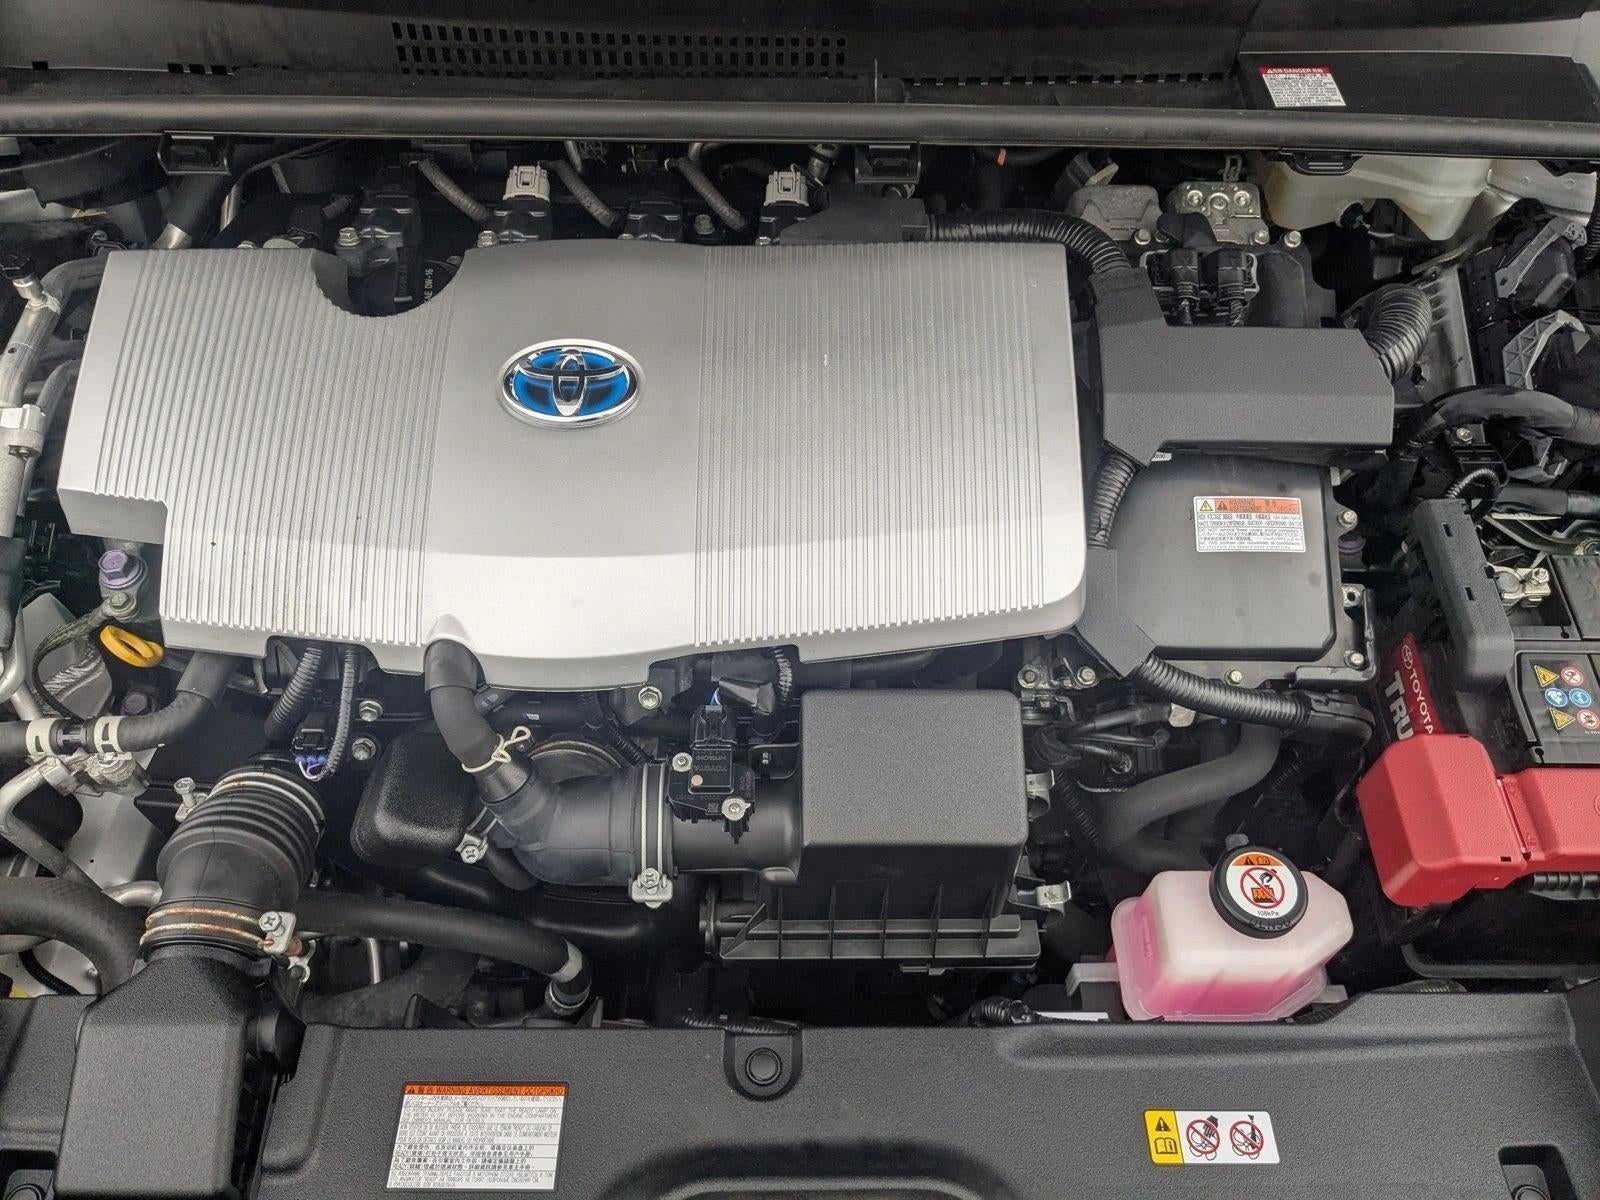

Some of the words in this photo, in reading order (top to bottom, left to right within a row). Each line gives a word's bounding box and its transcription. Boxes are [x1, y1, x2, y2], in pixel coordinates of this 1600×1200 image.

[1385, 669, 1414, 740] TRU
[1410, 668, 1434, 734] TOYOTA
[436, 1087, 467, 1095] WARNING
